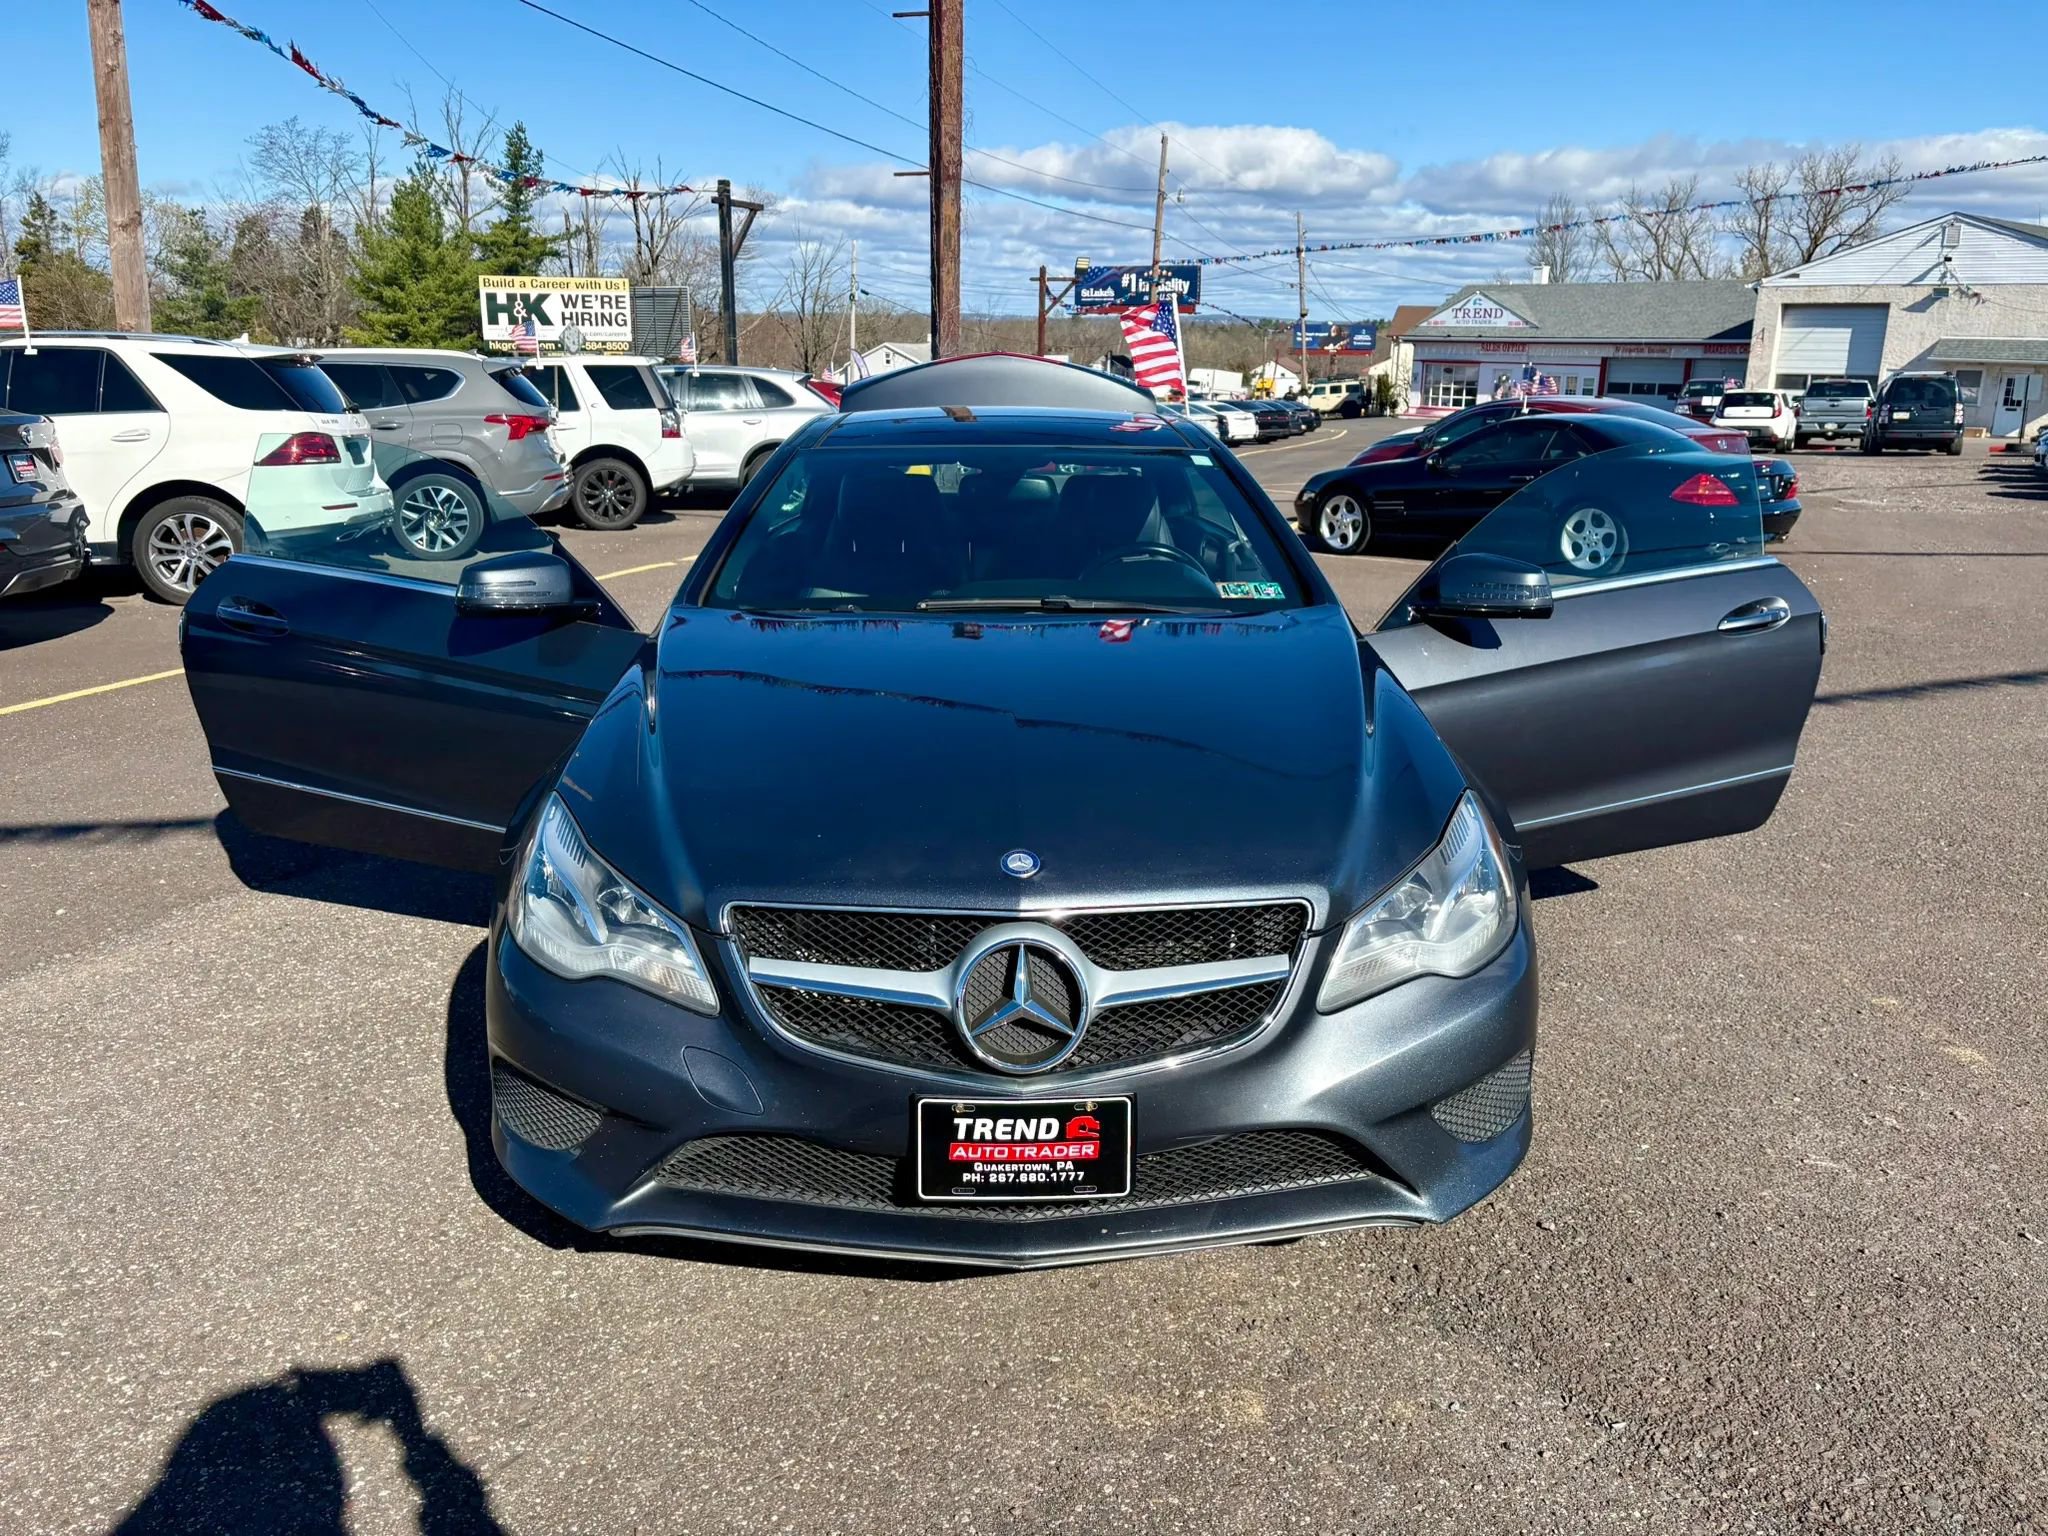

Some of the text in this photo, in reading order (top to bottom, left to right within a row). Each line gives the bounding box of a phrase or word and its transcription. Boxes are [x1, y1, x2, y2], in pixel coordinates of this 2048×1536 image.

[483, 278, 515, 288] Build
[519, 280, 527, 288] a
[530, 279, 570, 289] Career
[575, 279, 601, 290] with
[605, 280, 620, 290] Us
[1121, 273, 1137, 292] #1
[485, 292, 554, 326] H&K
[560, 294, 627, 310] WE'RE
[561, 312, 628, 327] HIRING
[1451, 308, 1504, 319] TREND
[953, 1118, 1060, 1140] TREND
[952, 1144, 1095, 1159] AUTO TRADER
[1056, 1161, 1074, 1170] PA
[962, 1171, 1085, 1183] PH: 267.680.1777
